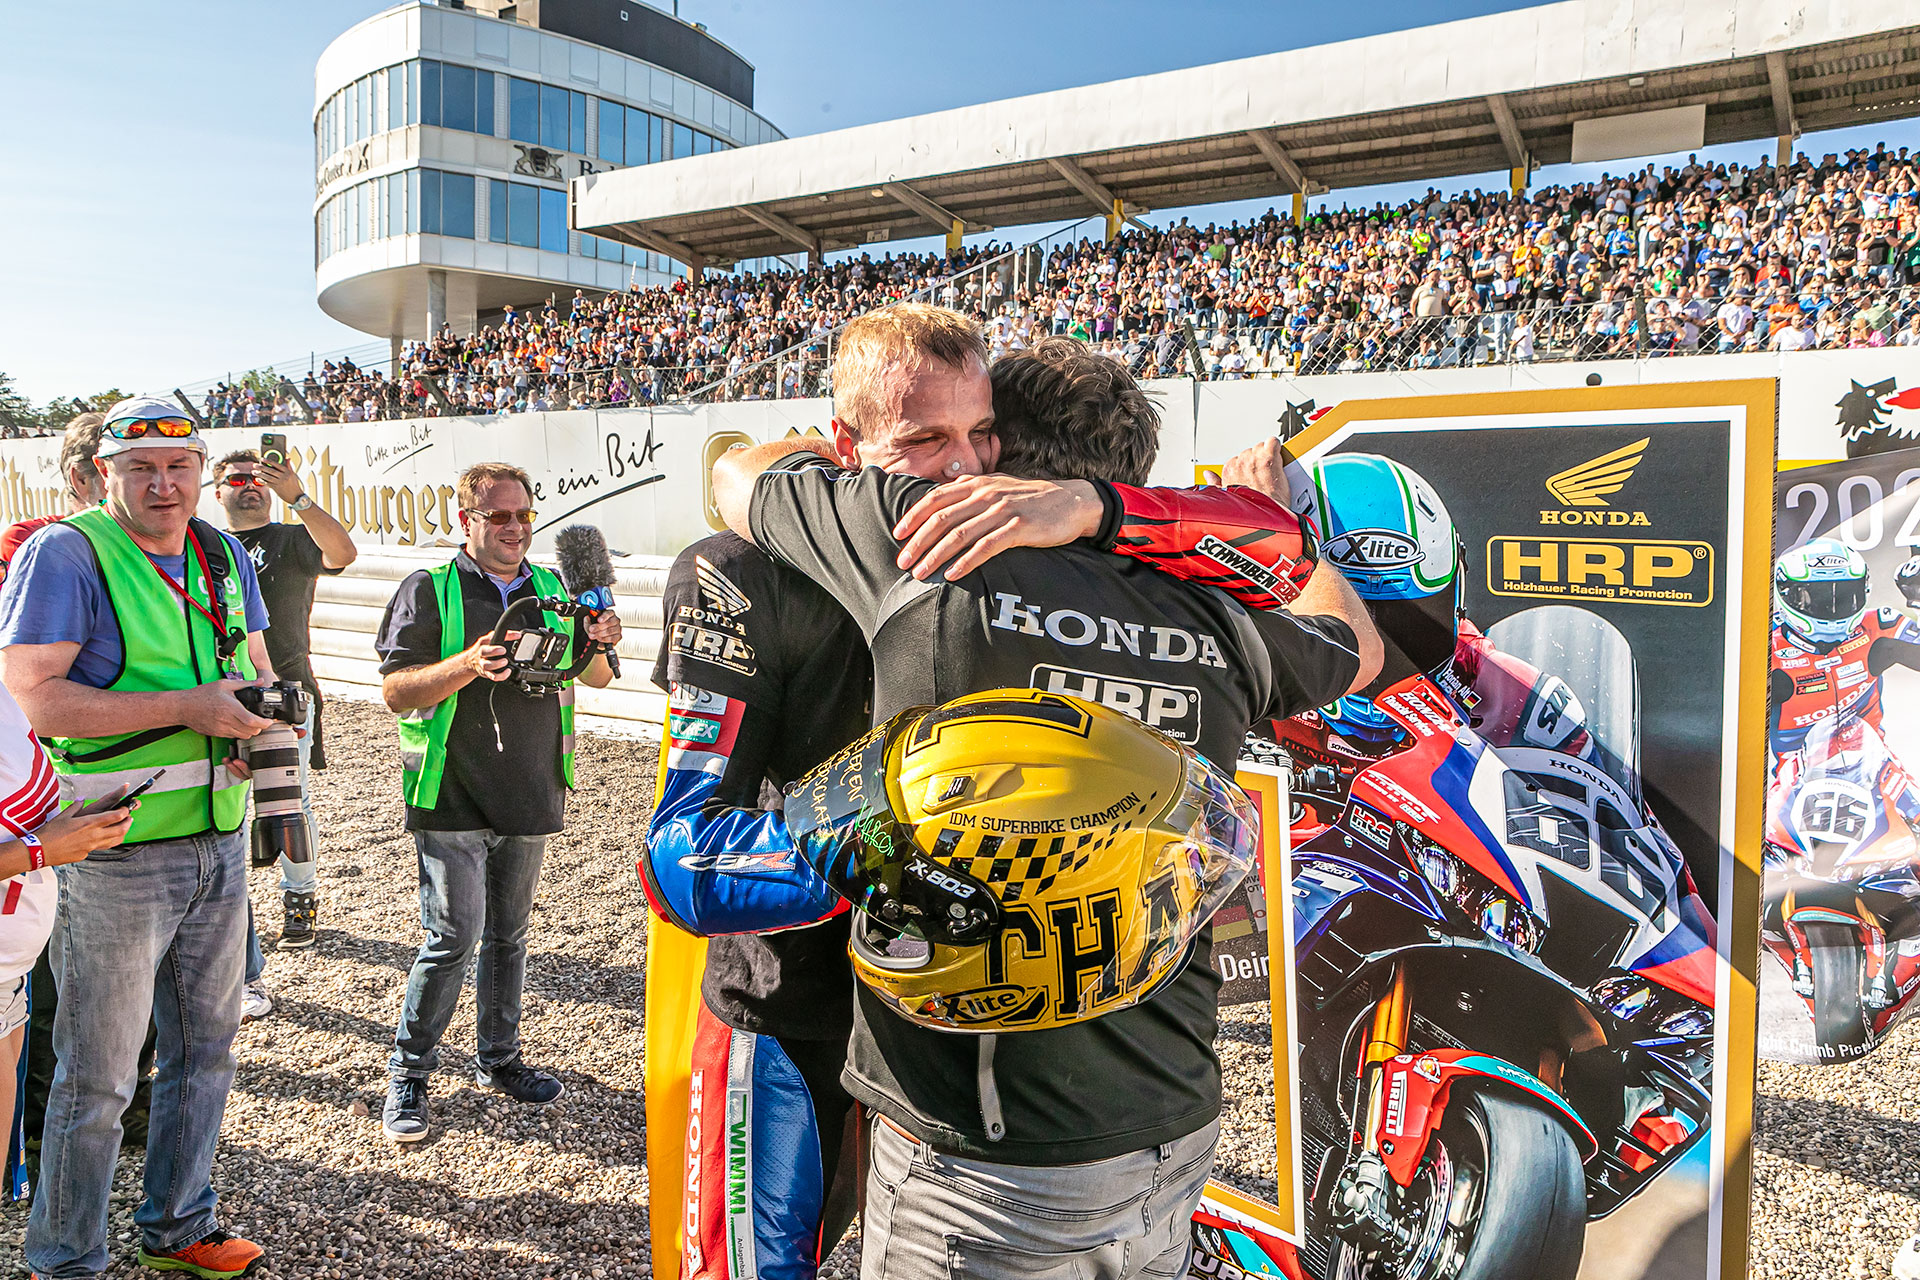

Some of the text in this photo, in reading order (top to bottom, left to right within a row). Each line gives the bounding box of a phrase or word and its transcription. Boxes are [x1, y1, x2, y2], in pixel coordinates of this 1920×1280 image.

[365, 423, 432, 467] Bitte ein Bit
[557, 468, 600, 495] ein
[606, 429, 664, 478] Bit
[1539, 510, 1652, 526] HONDA
[1198, 537, 1279, 590] SCHWABEN
[1338, 535, 1409, 562] X-lite
[1503, 581, 1693, 601] Holzhauer Racing Promotion
[679, 606, 747, 637] HONDA
[991, 592, 1228, 669] HONDA
[1548, 758, 1623, 806] HONDA
[949, 791, 1142, 834] IDM SUPERBIKE CHAMPION
[1799, 790, 1869, 842] 66
[910, 858, 977, 899] X-803
[942, 991, 1019, 1021] X-lite
[1386, 1071, 1408, 1136] PIRELLI
[686, 1071, 703, 1279] HONDA
[730, 1120, 746, 1215] WIMMI
[736, 1237, 746, 1278] Anlagenbau
